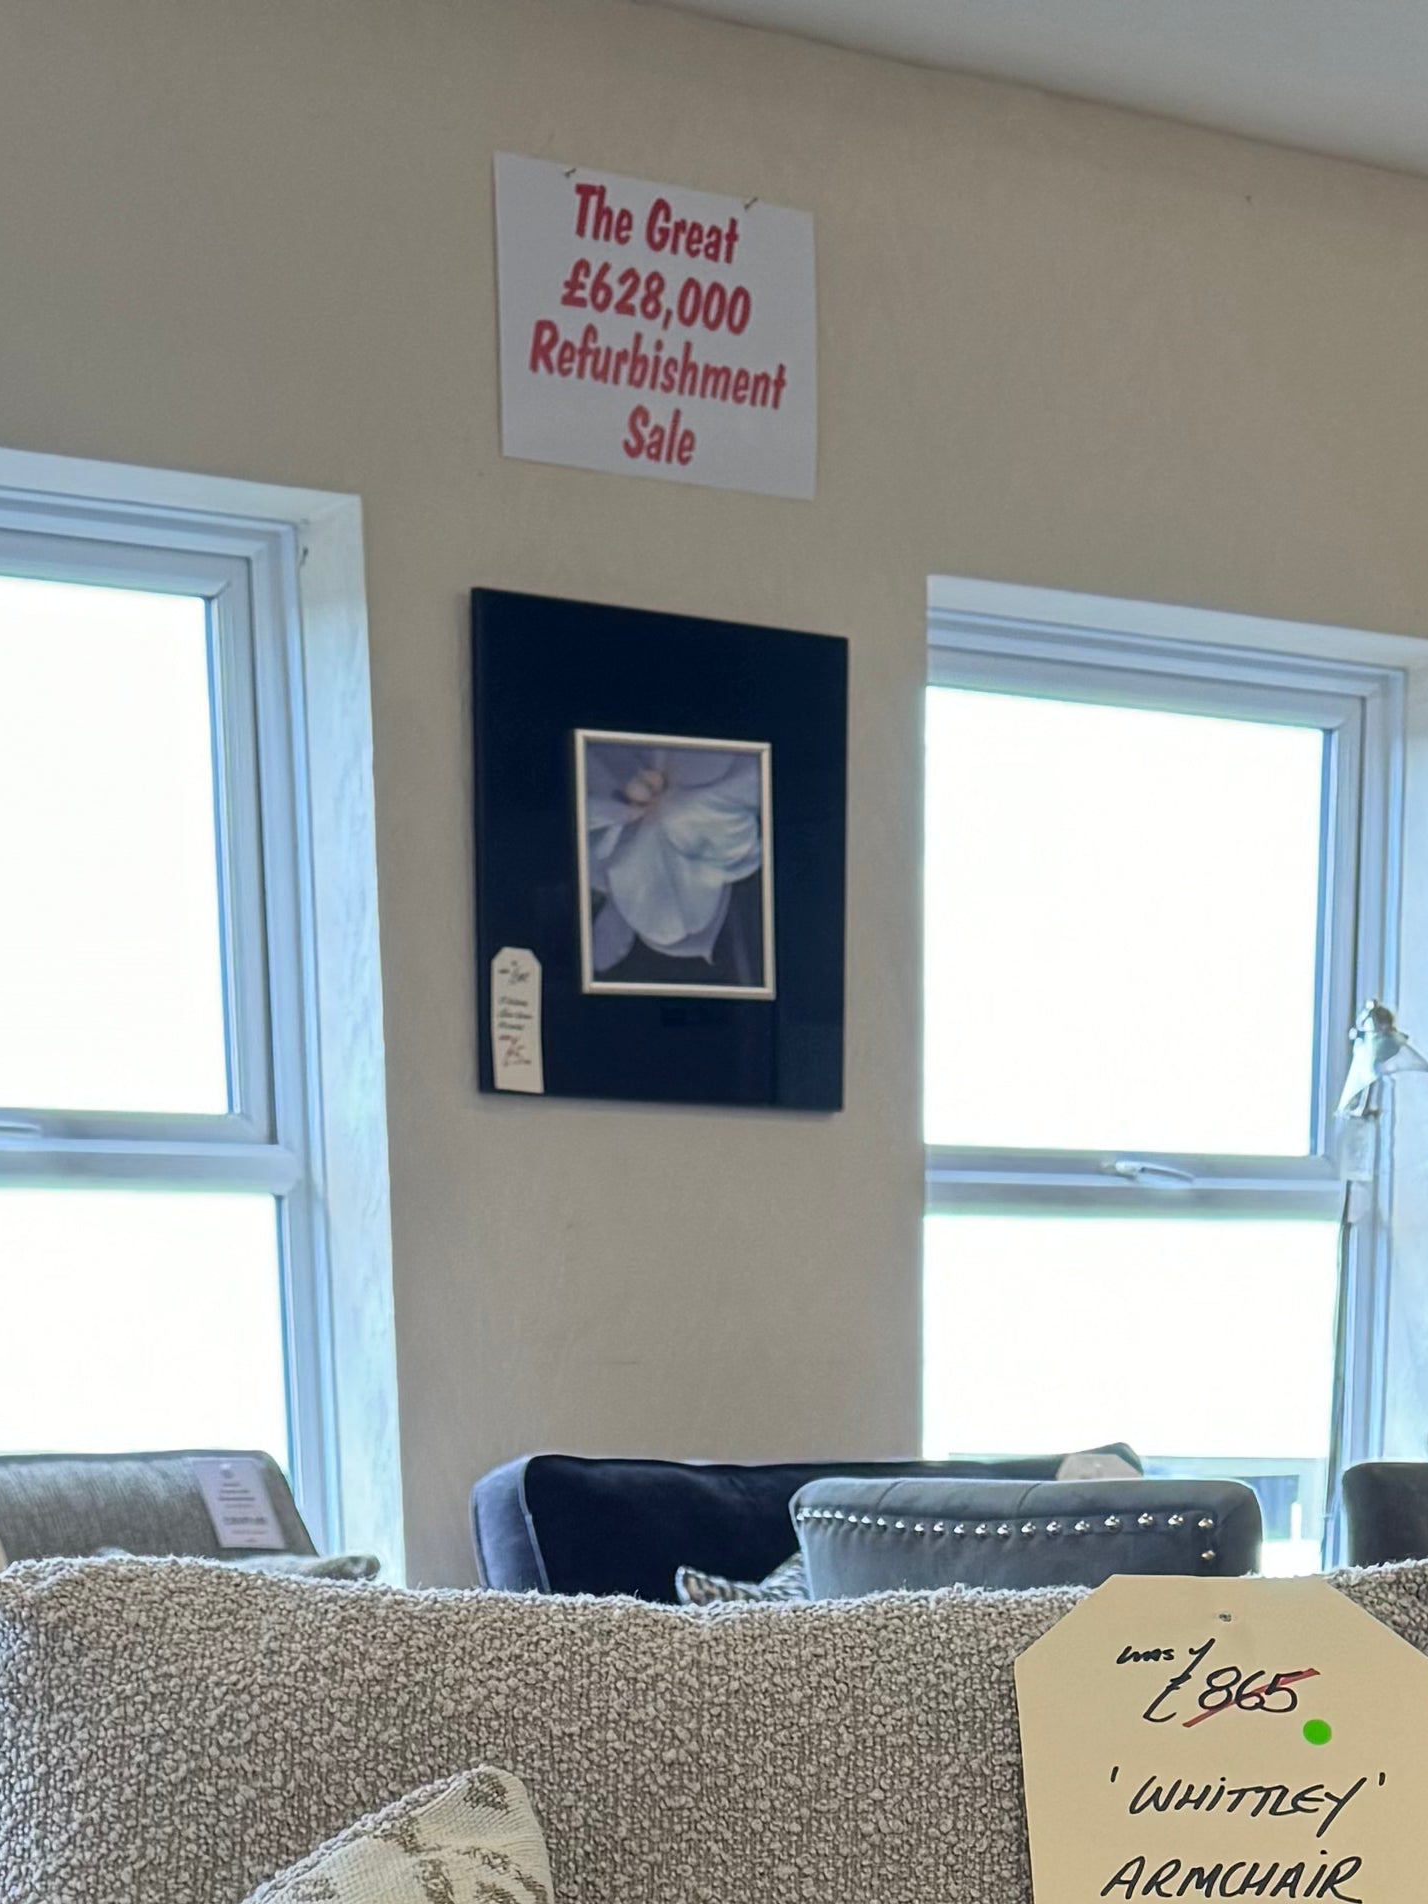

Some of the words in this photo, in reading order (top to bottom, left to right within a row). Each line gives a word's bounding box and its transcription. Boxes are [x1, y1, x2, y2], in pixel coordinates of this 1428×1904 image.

[575, 183, 633, 245] The
[645, 198, 739, 265] Great
[561, 258, 752, 335] £628,000
[529, 319, 787, 410] Refurbishment
[622, 403, 696, 466] Sale
[1143, 1638, 1312, 1728] £865
